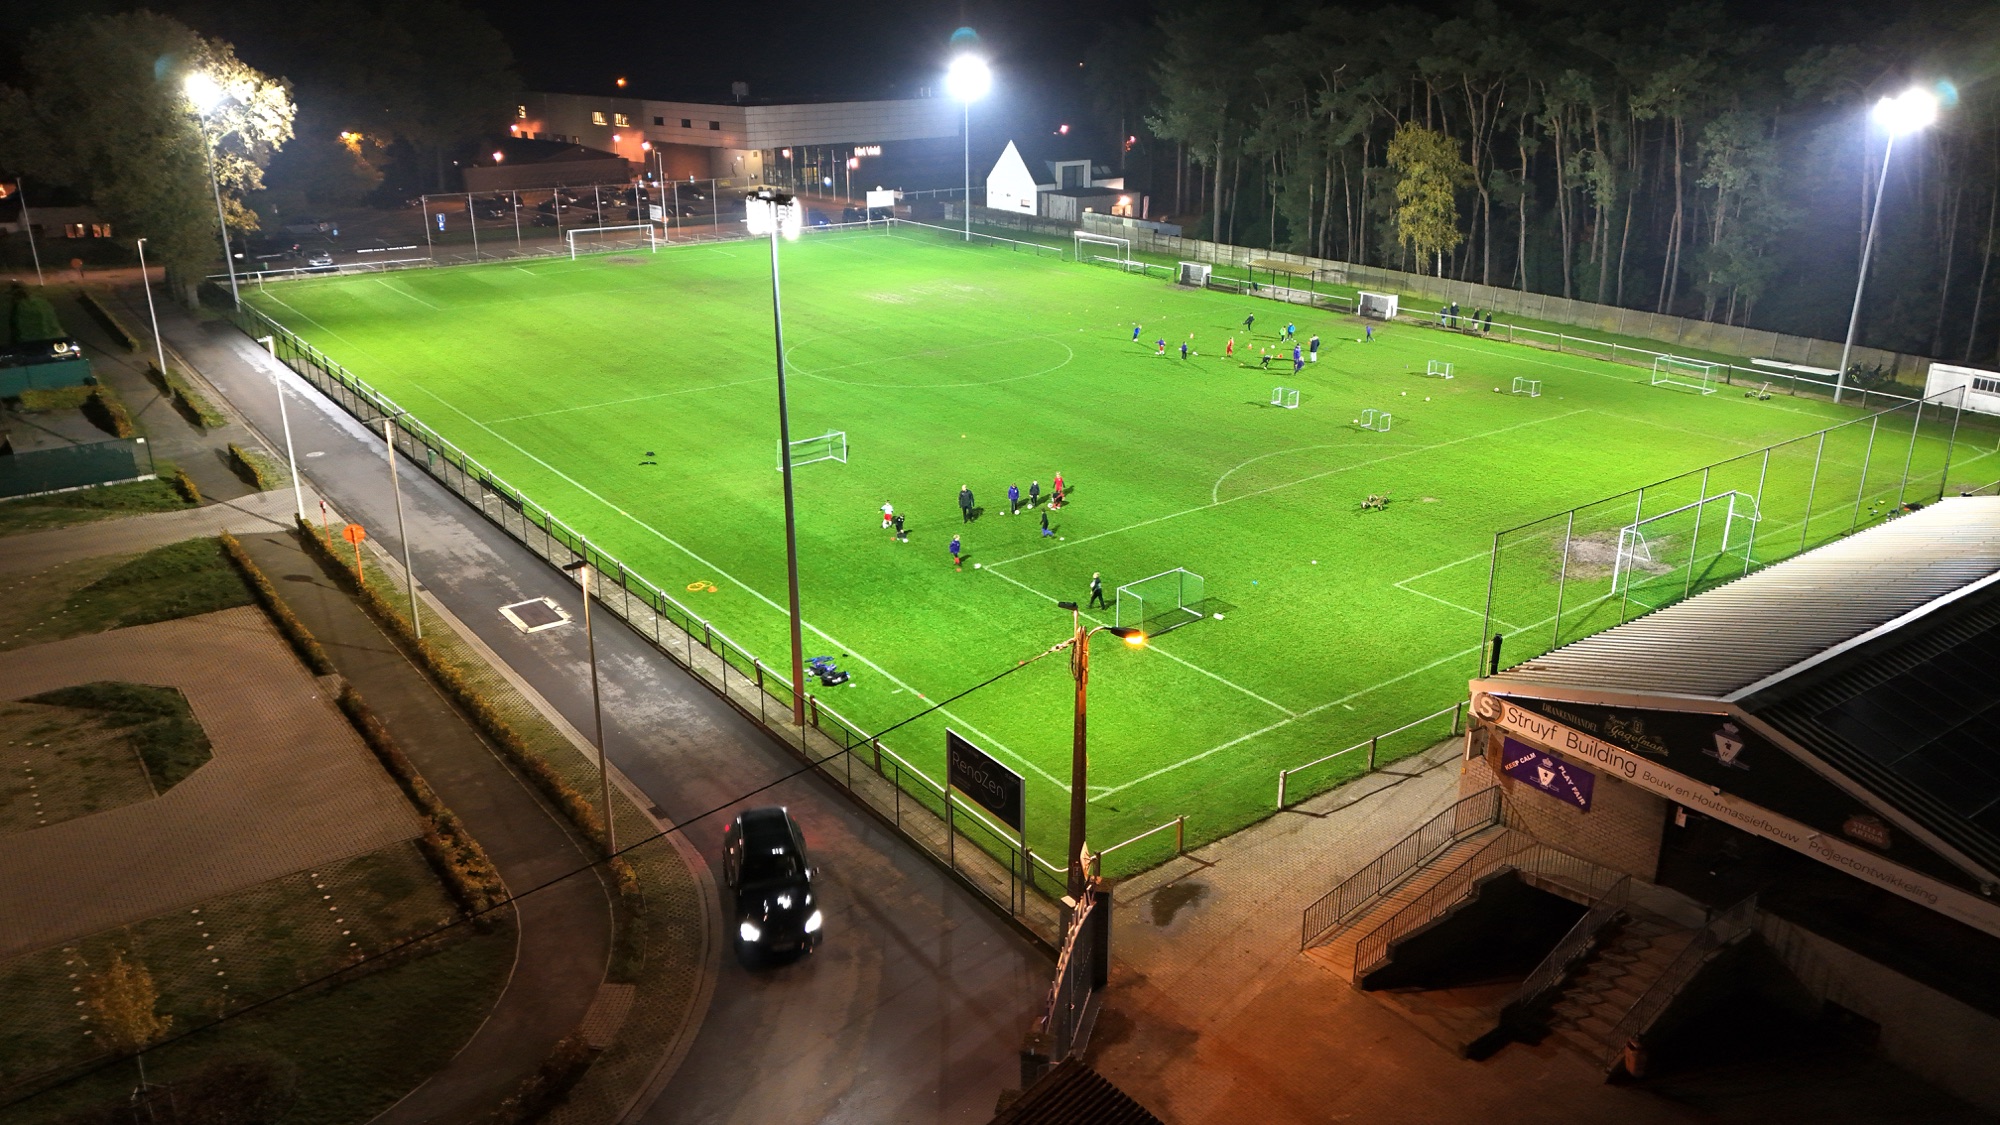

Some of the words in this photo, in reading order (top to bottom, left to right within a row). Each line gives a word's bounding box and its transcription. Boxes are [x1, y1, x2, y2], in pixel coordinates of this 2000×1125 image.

[1480, 696, 1494, 717] S
[952, 751, 1004, 799] RenoZen
[1504, 759, 1519, 771] KEEP
[1519, 752, 1537, 764] CALM
[1558, 765, 1574, 785] PLAY
[1571, 786, 1586, 806] FAIR
[1507, 707, 1558, 740] Struyf
[1566, 731, 1638, 778] Building
[1642, 770, 1674, 790] Bouw
[1675, 786, 1690, 799] en
[1692, 792, 1800, 844] Houtmassiefbouw
[1808, 840, 1938, 905] Projectontwikkeling
[1852, 821, 1883, 837] STELLA
